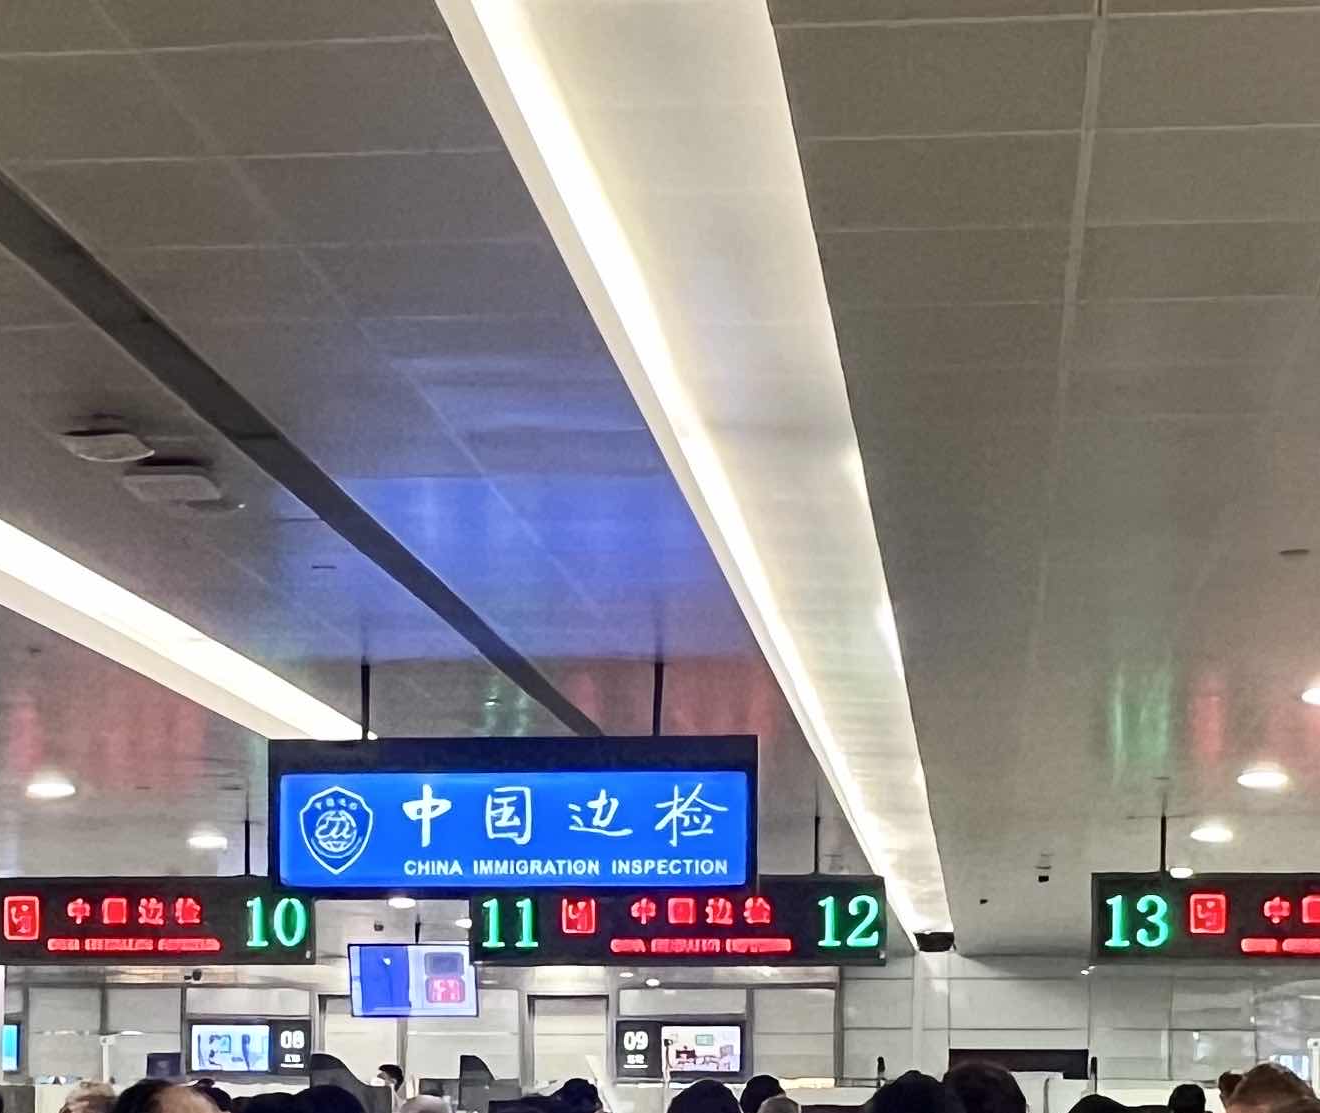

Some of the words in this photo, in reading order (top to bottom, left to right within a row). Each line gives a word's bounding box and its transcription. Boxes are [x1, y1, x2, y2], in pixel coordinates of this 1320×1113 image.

[401, 783, 729, 849] 中国边检
[404, 859, 463, 876] CHINA
[473, 859, 600, 876] IMMIGRATION
[612, 859, 728, 876] INSPECTION
[245, 895, 308, 949] 10
[481, 898, 539, 949] 11
[818, 894, 881, 949] 12
[1104, 894, 1170, 949] 13
[622, 1030, 649, 1052] 09
